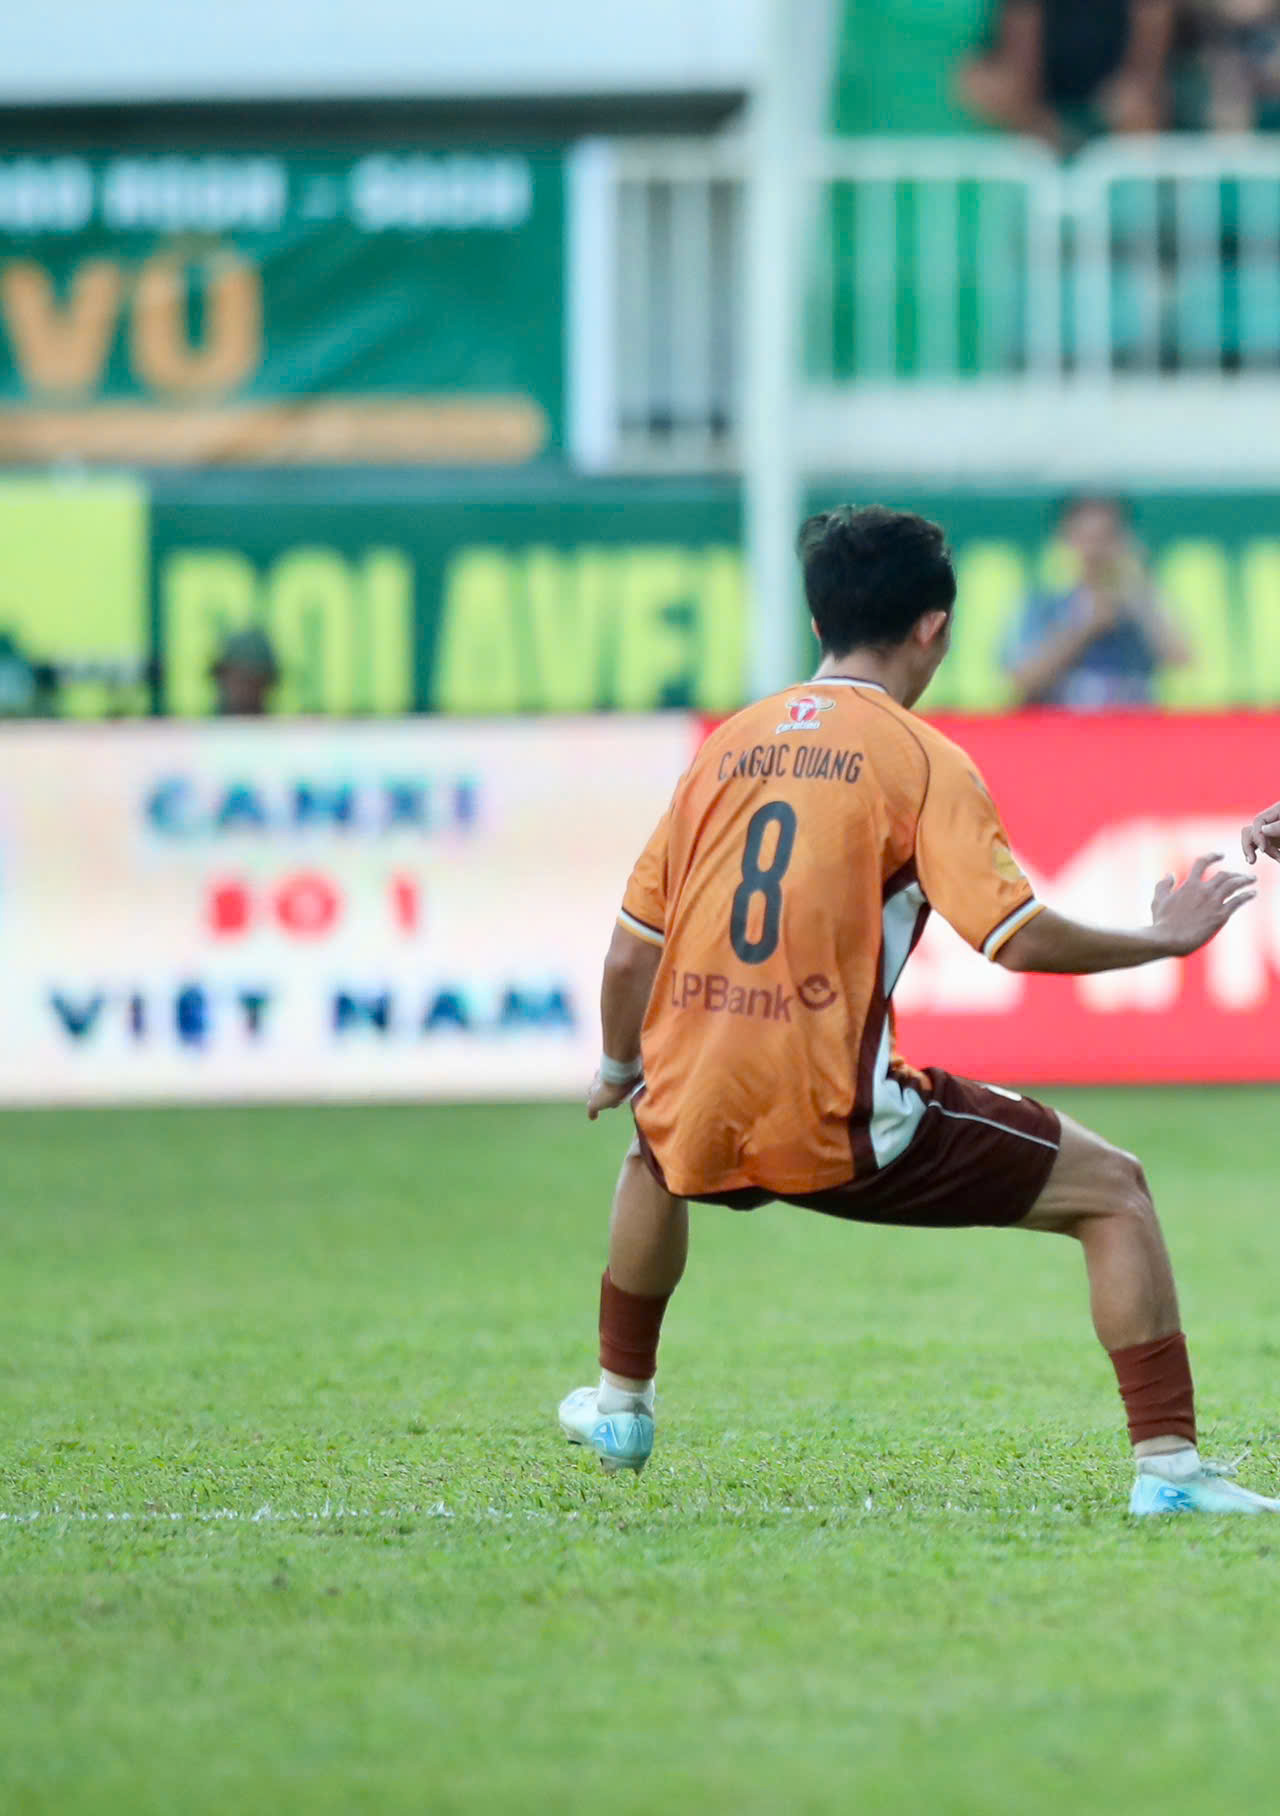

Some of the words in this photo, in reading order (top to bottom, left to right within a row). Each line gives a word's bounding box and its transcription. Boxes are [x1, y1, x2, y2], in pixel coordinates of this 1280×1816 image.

[793, 746, 864, 784] QUANG
[730, 801, 796, 964] 8
[671, 969, 792, 1024] LPBank
